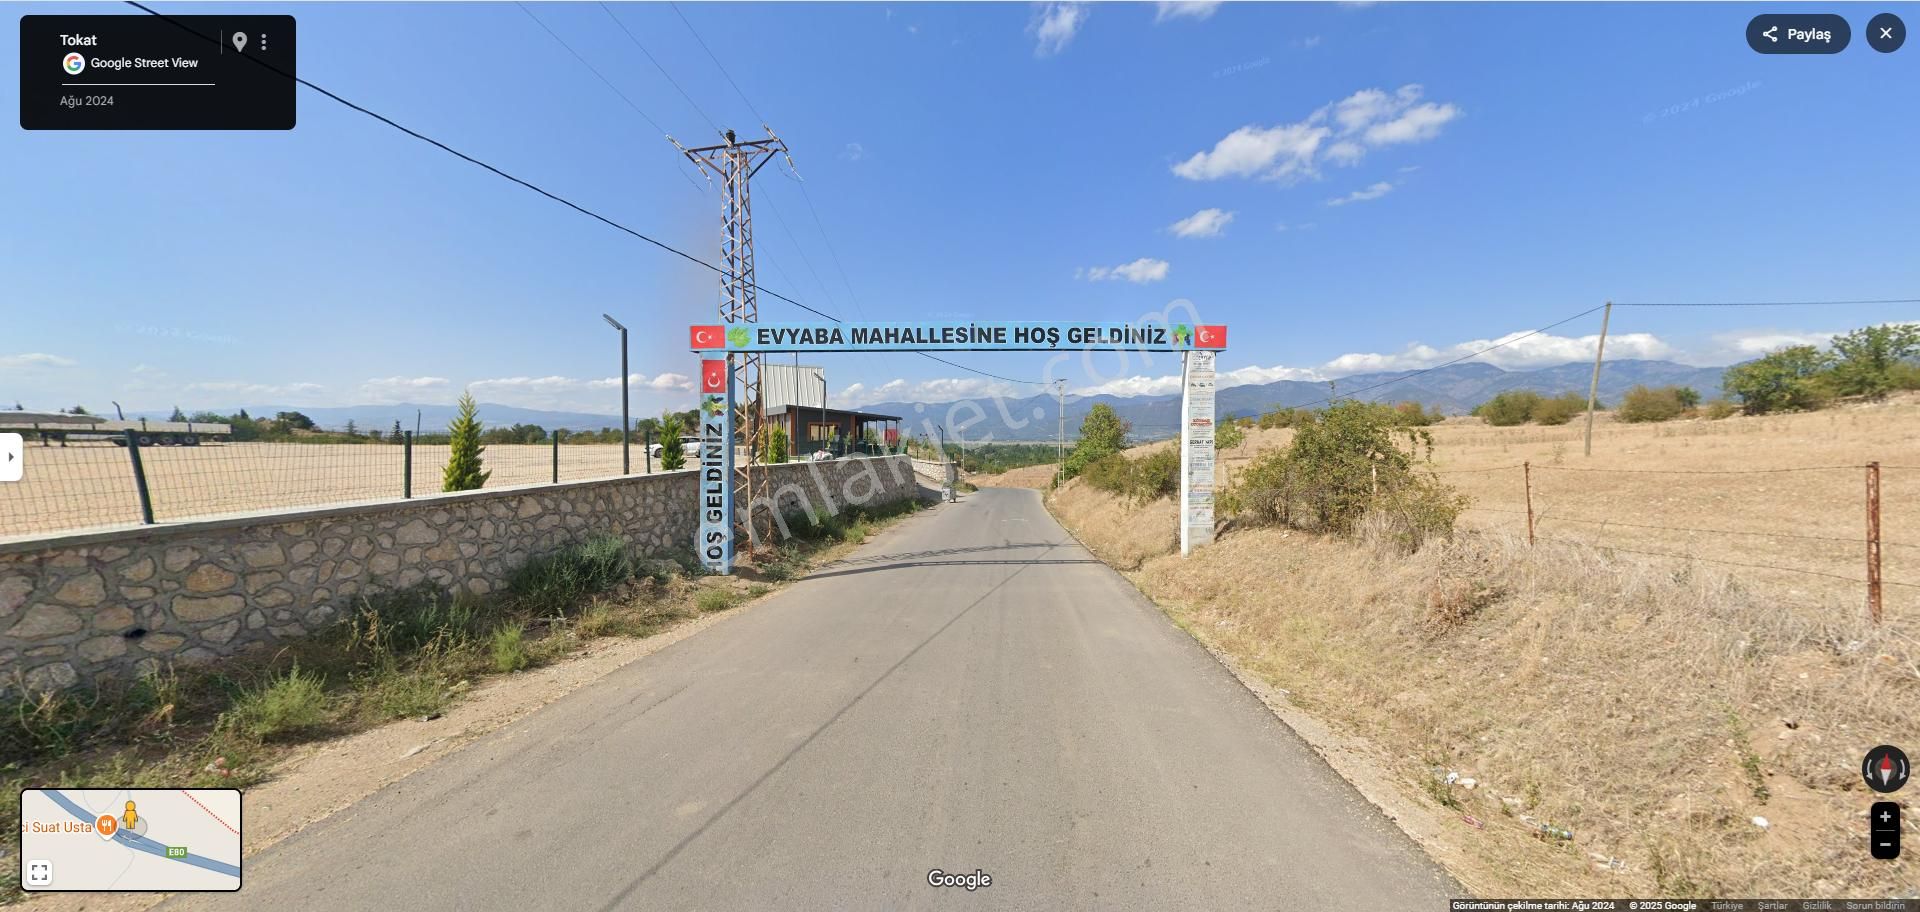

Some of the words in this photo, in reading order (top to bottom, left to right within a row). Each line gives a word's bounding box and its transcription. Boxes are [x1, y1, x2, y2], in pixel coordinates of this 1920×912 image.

[757, 328, 845, 345] EVYABA
[851, 323, 1007, 345] MAHALLESİNE
[1014, 327, 1060, 347] HOŞ
[1067, 324, 1167, 345] GELDİNİZ
[702, 423, 723, 523] GELDİNİZ
